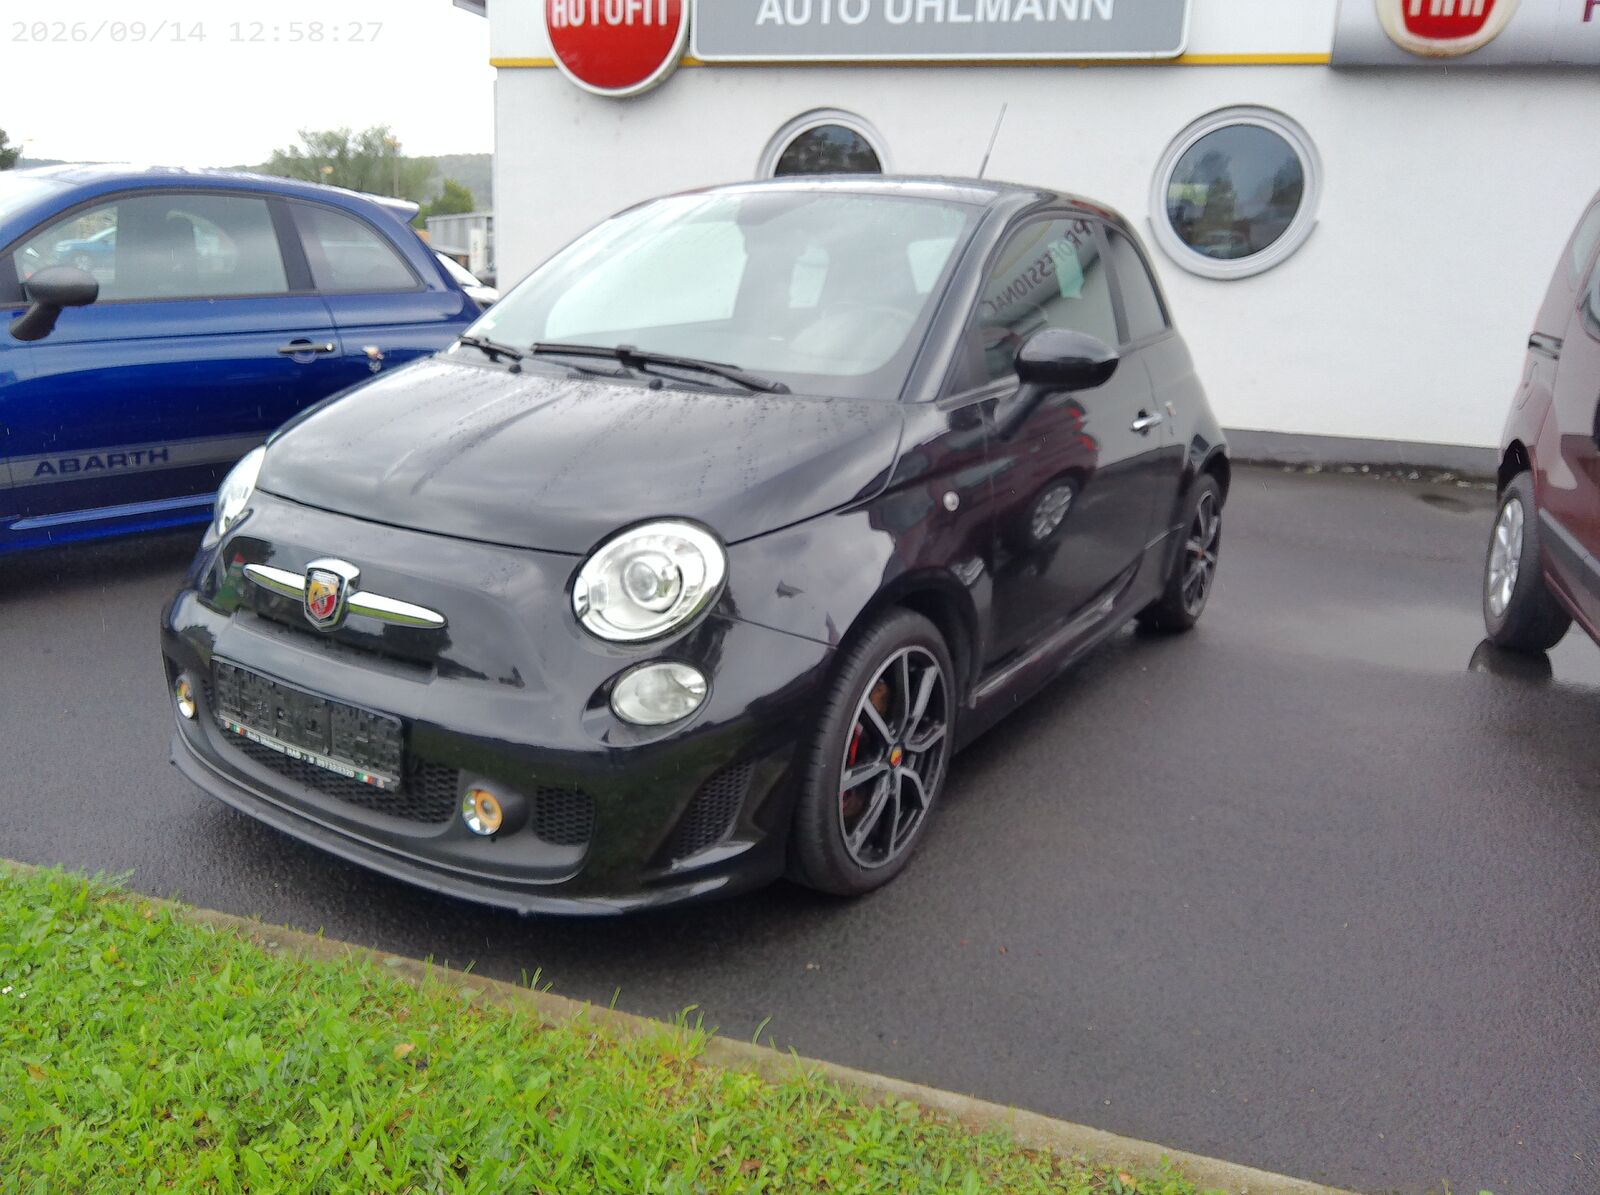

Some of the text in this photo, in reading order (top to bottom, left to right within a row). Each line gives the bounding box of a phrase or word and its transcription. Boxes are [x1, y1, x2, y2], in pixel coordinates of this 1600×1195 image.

[755, 0, 1115, 26] AUTO UHLMANN
[33, 446, 169, 477] ABARTH
